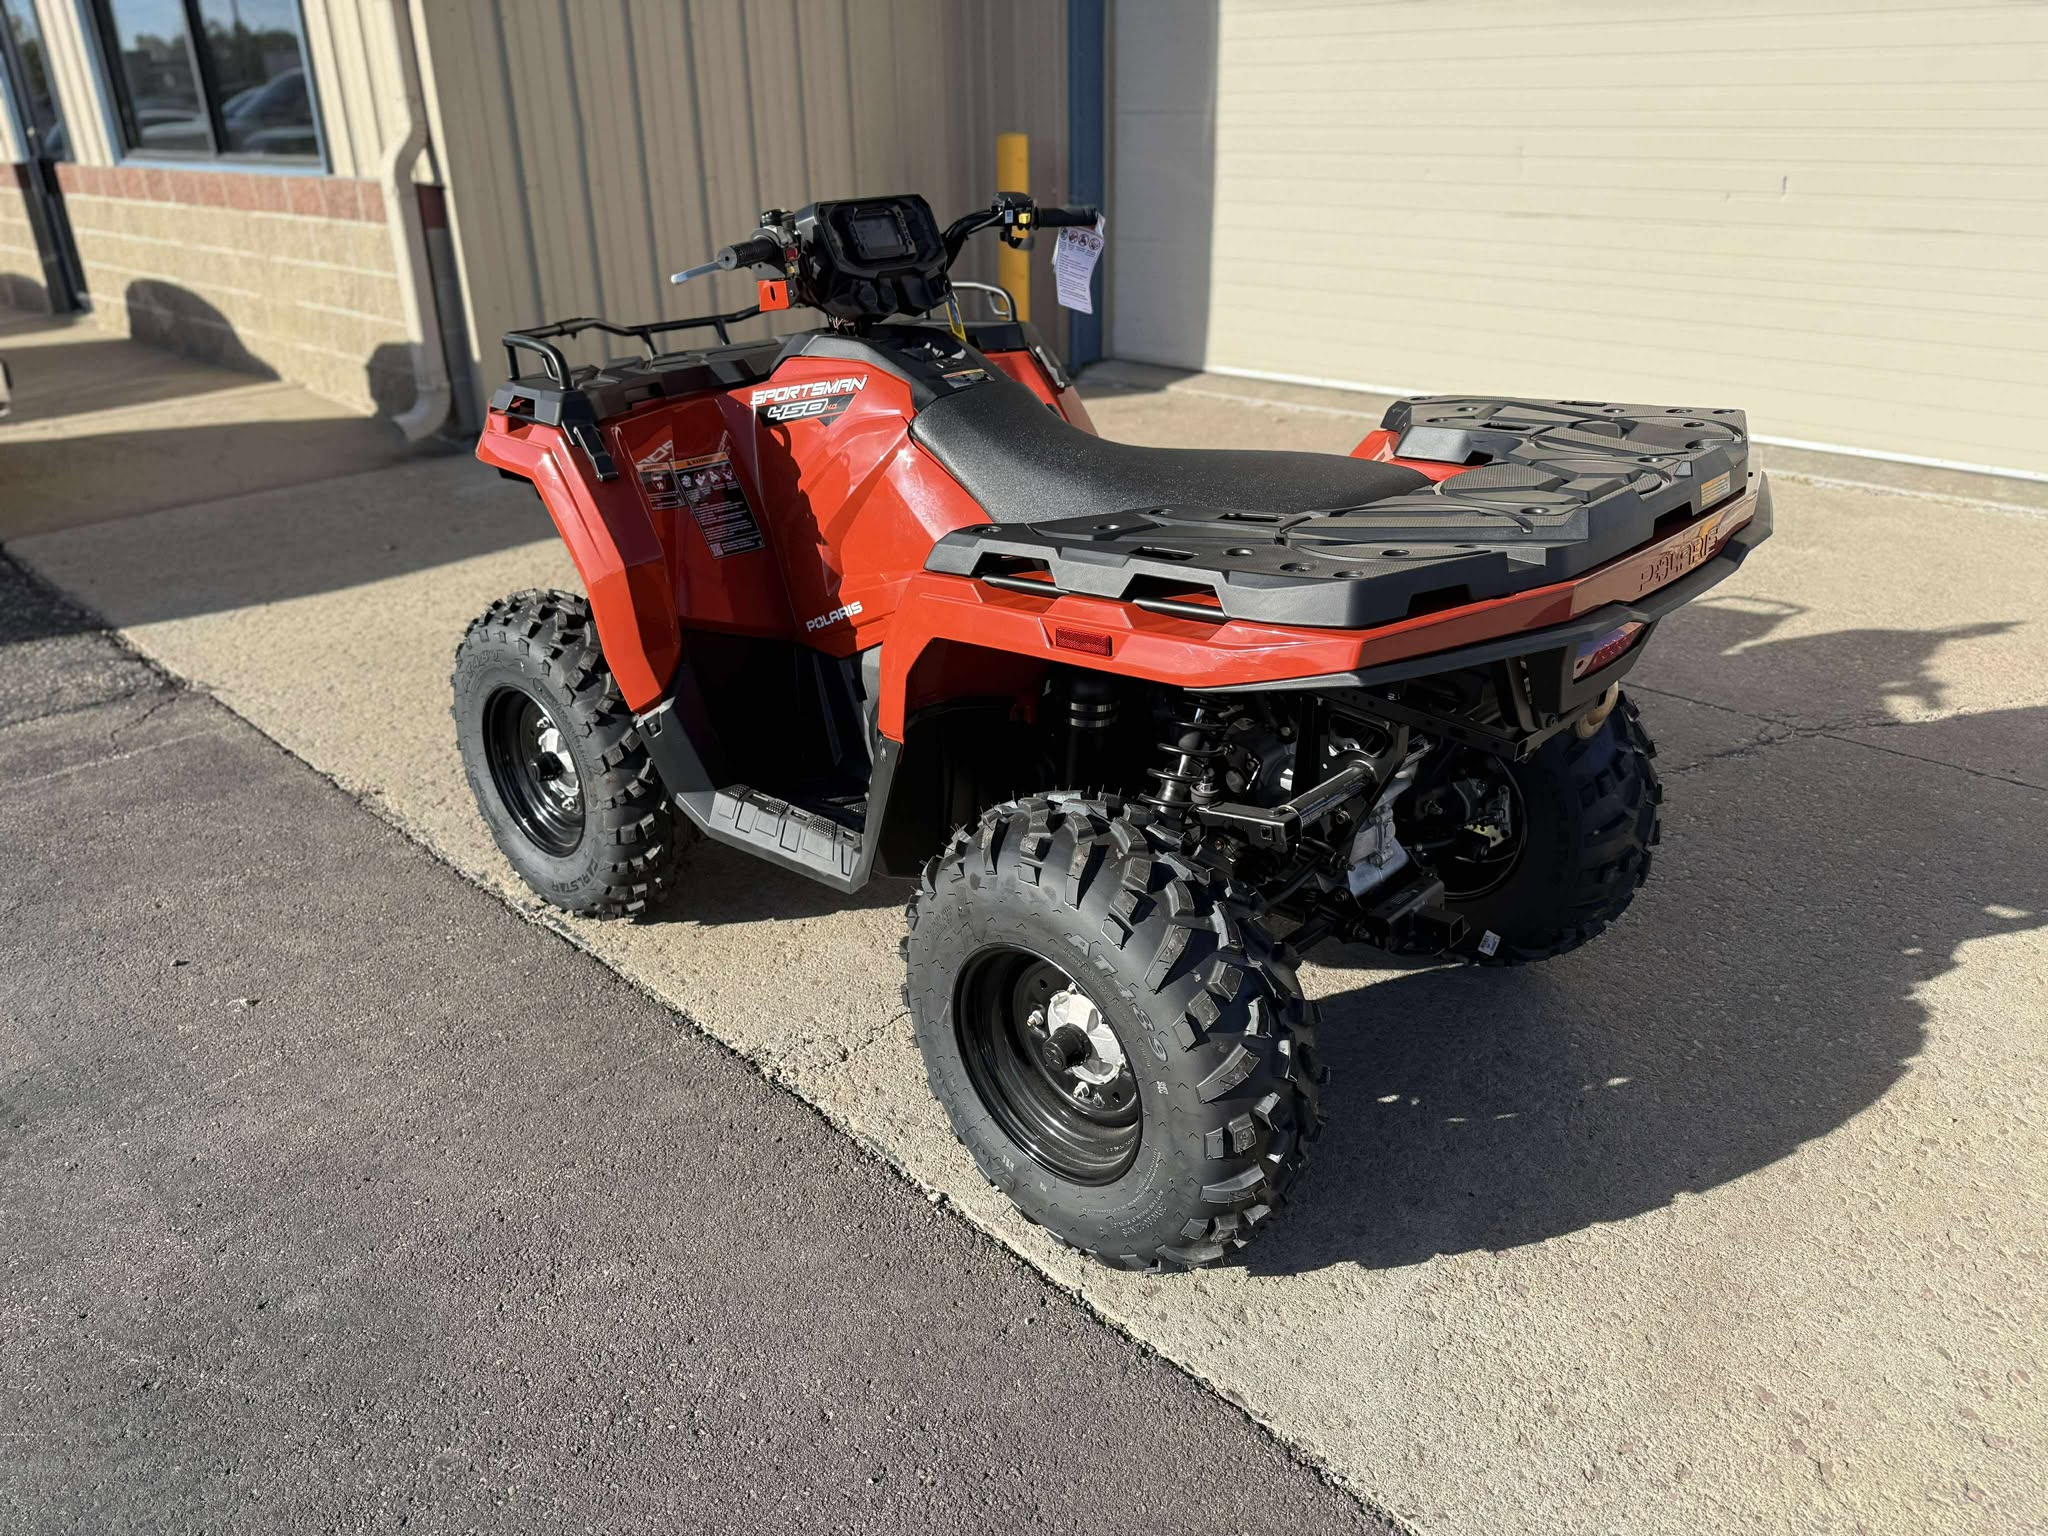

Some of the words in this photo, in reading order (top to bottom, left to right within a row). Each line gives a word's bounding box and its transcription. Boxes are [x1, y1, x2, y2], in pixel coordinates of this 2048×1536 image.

[750, 375, 868, 405] SPORTSMAN
[767, 398, 829, 420] 450
[805, 601, 863, 632] POLARIS
[1064, 933, 1168, 1062] AT489
